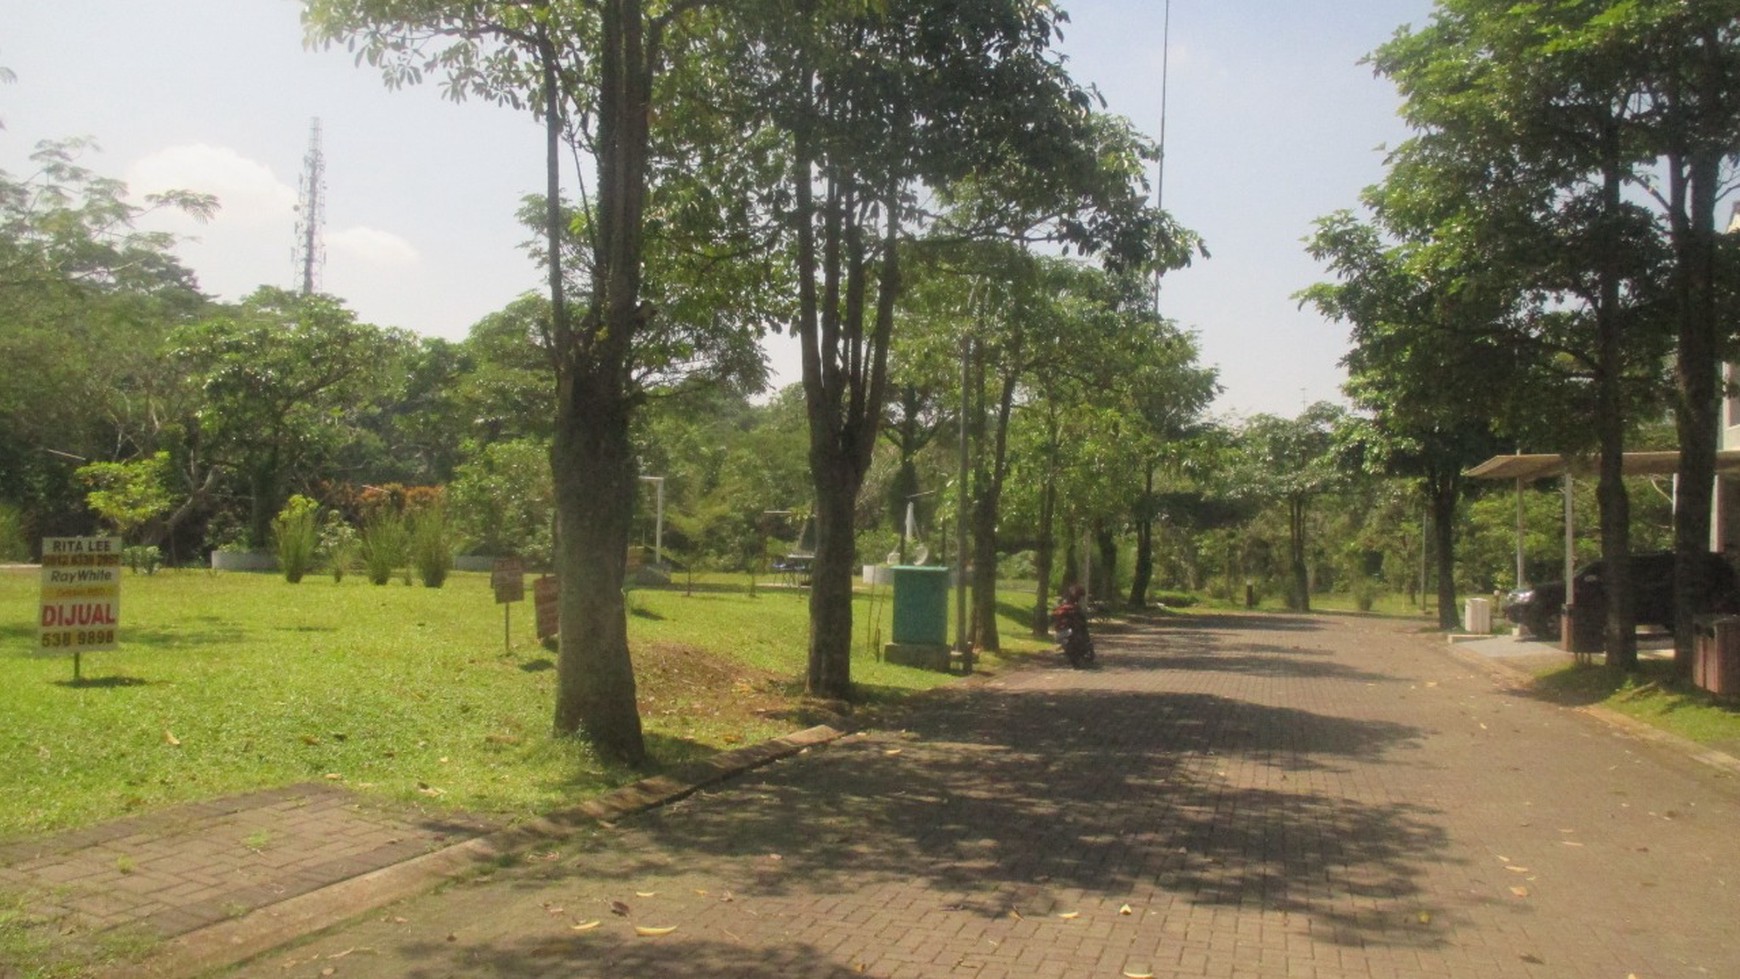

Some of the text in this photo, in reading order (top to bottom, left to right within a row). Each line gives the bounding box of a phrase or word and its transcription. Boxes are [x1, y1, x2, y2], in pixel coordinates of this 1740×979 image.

[53, 541, 111, 552] RITA LEE
[42, 603, 115, 627] DIJUAL
[42, 630, 113, 648] 538 9898
